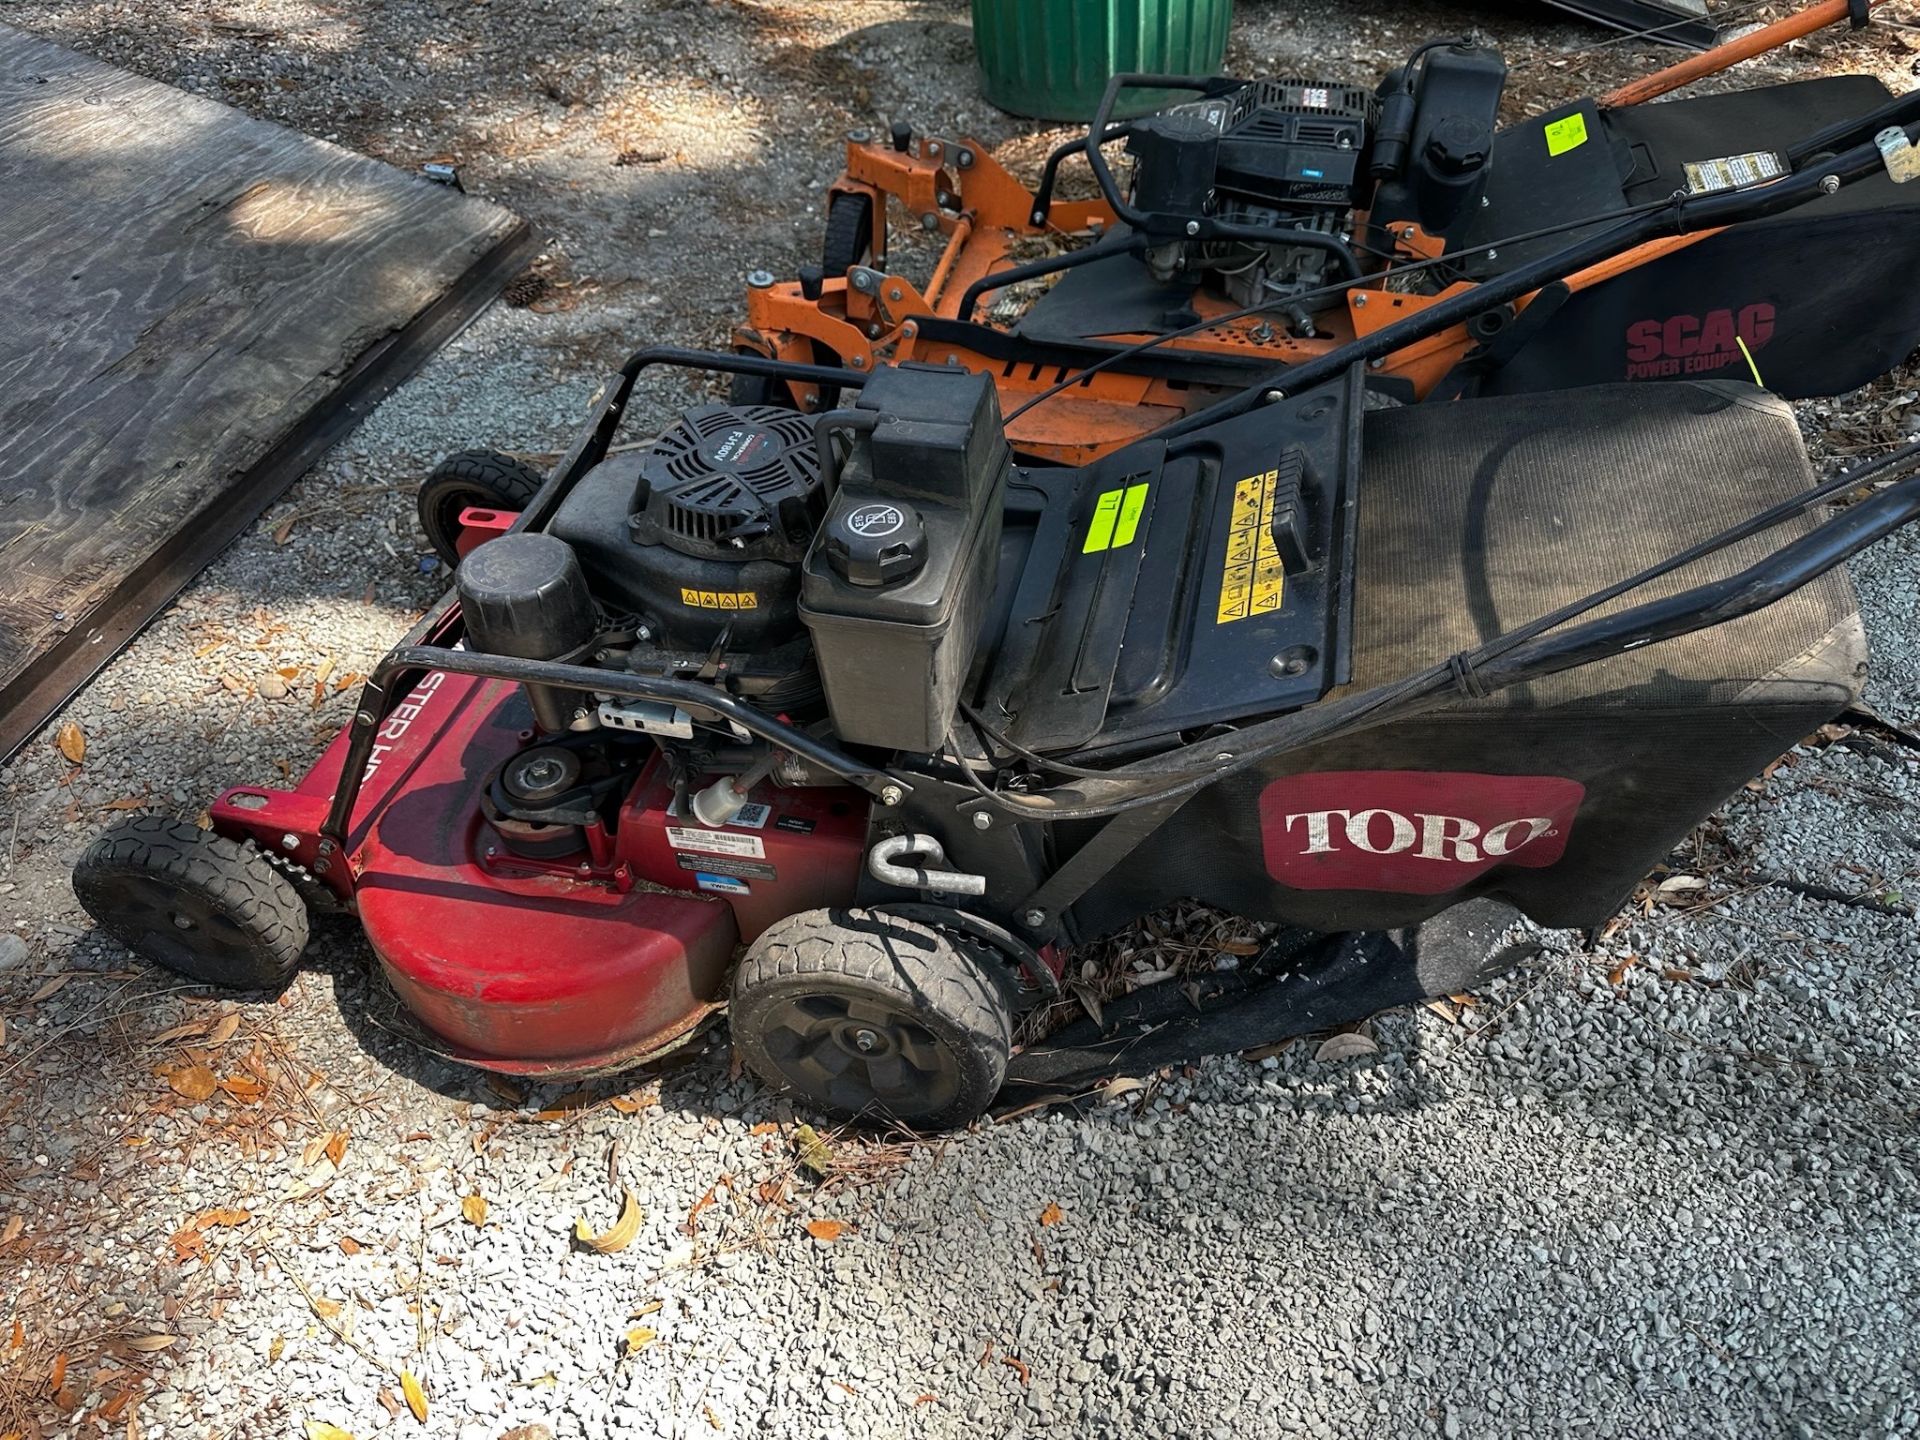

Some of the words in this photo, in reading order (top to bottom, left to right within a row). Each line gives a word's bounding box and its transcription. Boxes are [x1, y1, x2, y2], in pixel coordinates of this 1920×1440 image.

[1627, 358, 1681, 379] POWER
[1684, 349, 1745, 374] EQUIPM
[714, 431, 743, 461] FJ180V
[855, 515, 865, 528] E15
[377, 672, 445, 738] STER
[360, 743, 393, 789] HD
[1285, 808, 1553, 862] TORO
